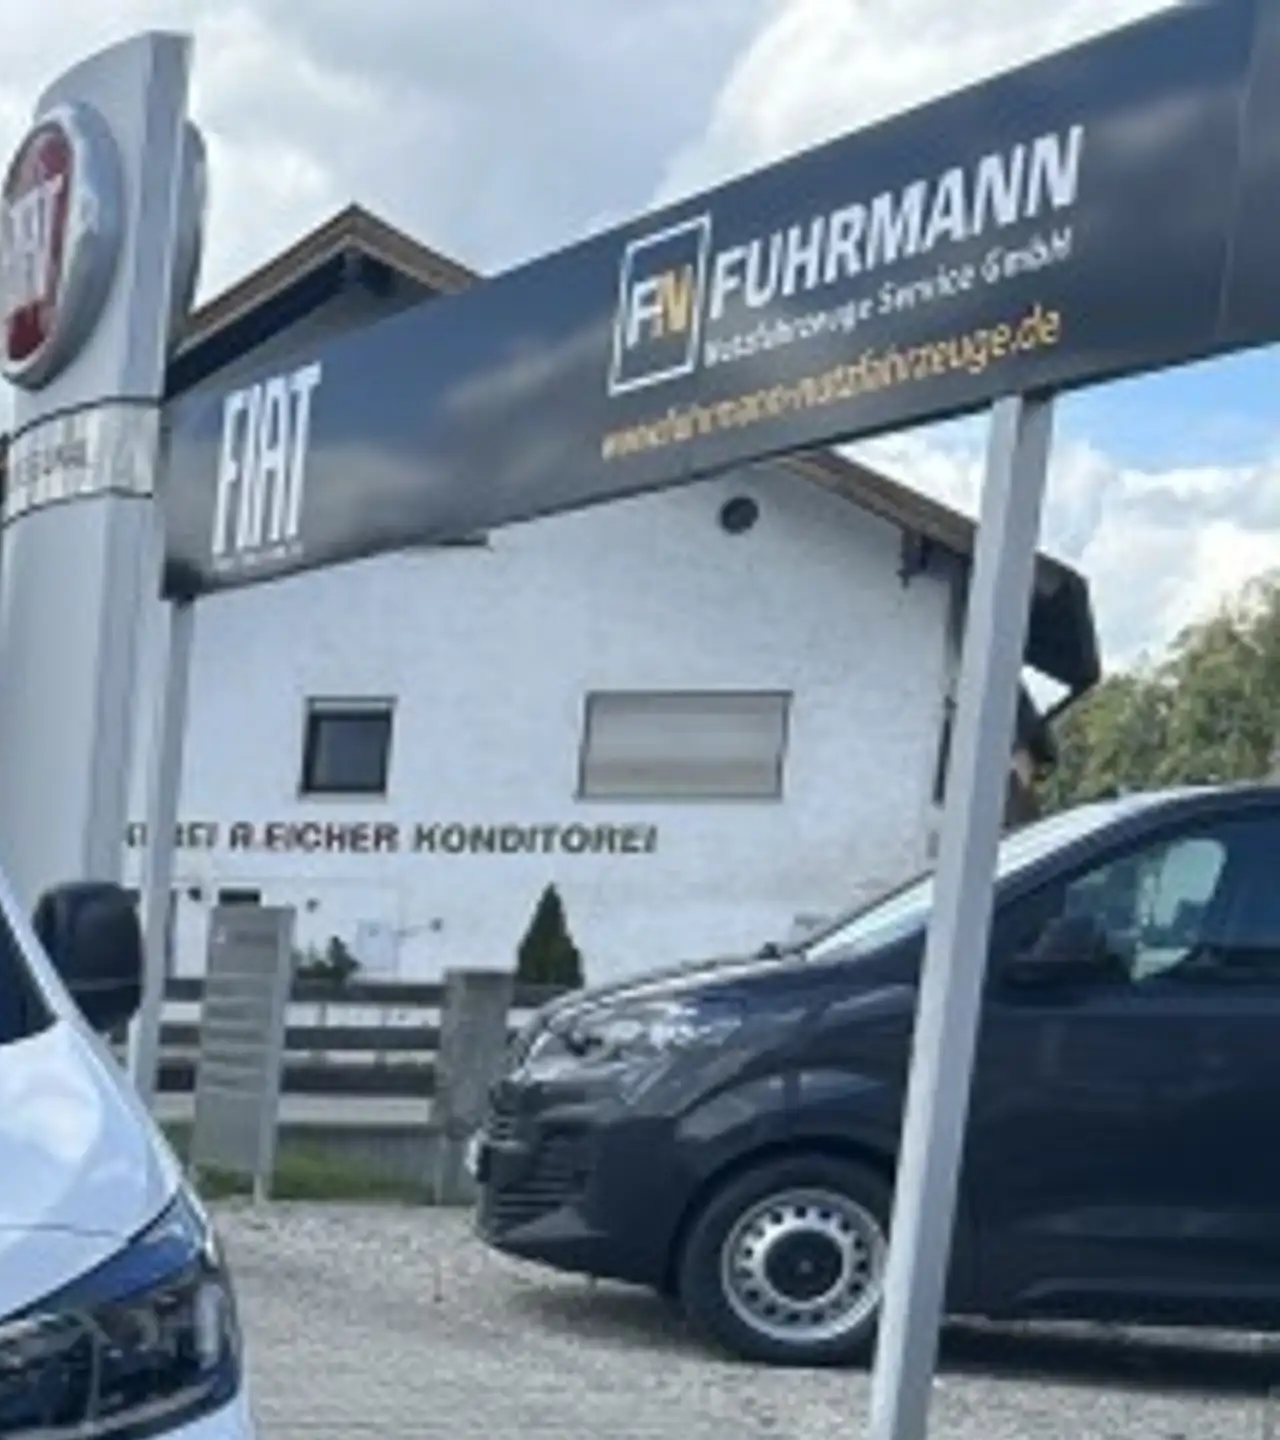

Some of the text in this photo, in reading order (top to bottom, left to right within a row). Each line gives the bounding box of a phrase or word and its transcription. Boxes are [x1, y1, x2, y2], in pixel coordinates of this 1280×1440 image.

[709, 124, 1084, 321] FUHRMANN
[877, 261, 975, 315] Service
[980, 225, 1073, 285] GmbH
[211, 360, 323, 556] FIAT
[414, 821, 659, 855] KONDITOREI
